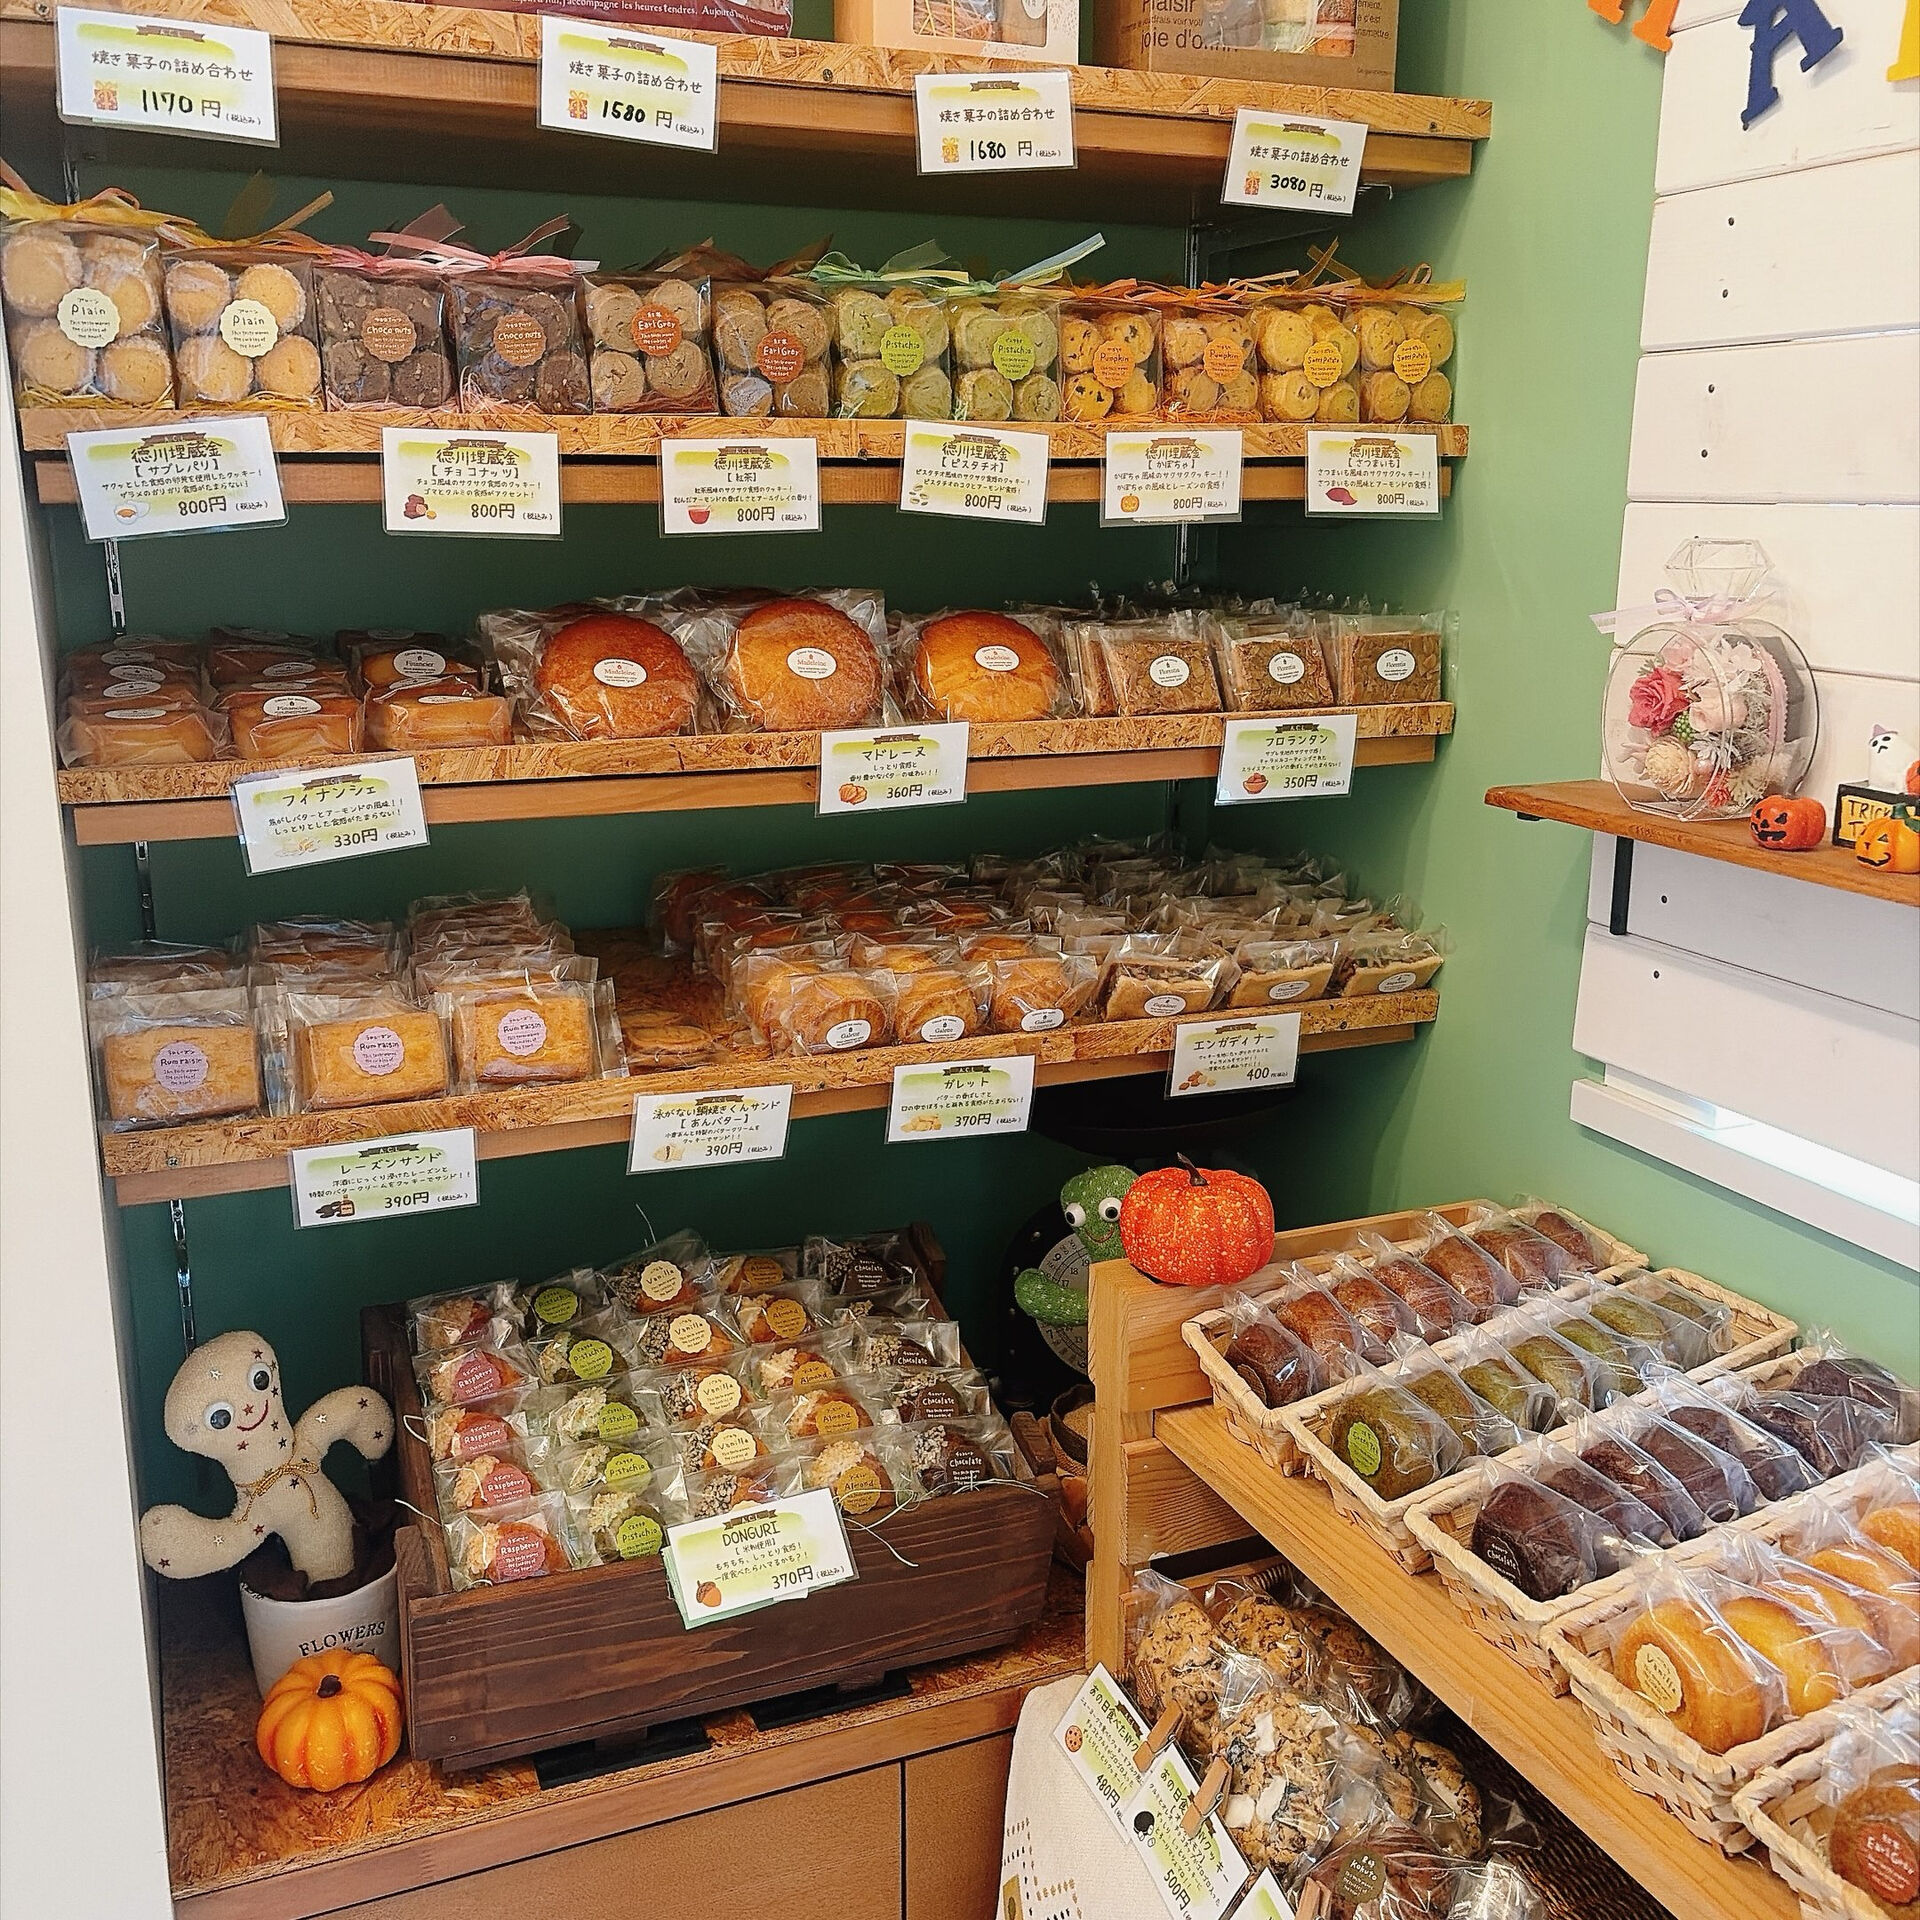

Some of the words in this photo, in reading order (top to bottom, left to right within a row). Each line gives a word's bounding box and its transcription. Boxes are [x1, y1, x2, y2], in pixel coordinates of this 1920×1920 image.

[621, 2, 633, 10] les
[635, 4, 663, 12] heures
[664, 4, 698, 15] tendres.
[1141, 27, 1168, 53] joie
[92, 49, 253, 82] 焼き菓子の詰め合わせ
[569, 60, 702, 94] 焼き菓子の詰め合わせ
[142, 89, 193, 114] 1170
[602, 100, 646, 123] 1580
[939, 108, 1055, 123] 焼き菓子の詰め合わせ
[970, 140, 1007, 161] 1680
[1250, 146, 1350, 167] 焼き菓子の詰め合わせ
[1270, 174, 1307, 191] 3080
[72, 304, 106, 315] Plain
[233, 315, 264, 326] Plain
[498, 333, 523, 341] Choco
[886, 341, 920, 349] Pistachio
[998, 346, 1032, 354] Pistachio
[131, 441, 222, 463] 徳川埋蔵金
[437, 450, 519, 466] 徳川埋蔵金
[942, 442, 1011, 462] 徳川埋蔵金
[1146, 446, 1201, 460] 徳川埋蔵金
[1349, 447, 1402, 458] 徳川埋蔵金
[714, 457, 773, 470] 徳川埋蔵金
[179, 496, 227, 516] 800円
[965, 494, 1001, 510] 800円
[1173, 497, 1203, 509] 800円
[1377, 493, 1405, 505] 800円
[471, 503, 515, 519] 800円
[737, 506, 775, 522] 800円
[1266, 735, 1328, 746] フロランタン
[862, 747, 926, 761] マドレーヌ
[1284, 775, 1317, 788] 350円
[282, 785, 377, 806] フィナンシェ
[887, 784, 923, 799] 360円
[334, 828, 378, 848] 330円
[1194, 1034, 1275, 1050] エンガディナー
[944, 1077, 989, 1089] ガレット
[955, 1113, 991, 1127] 370円
[706, 1142, 742, 1157] 390円
[341, 1152, 442, 1174] レーズンサンド
[385, 1192, 429, 1208] 390円
[855, 1263, 883, 1272] Chocolate
[647, 1268, 674, 1285] Vanilla
[674, 1322, 703, 1336] Vanilla
[897, 1357, 928, 1365] Chocolate
[458, 1368, 494, 1388] Raspberry
[800, 1373, 828, 1384] Almond
[703, 1383, 735, 1396] Vanilla
[923, 1397, 955, 1405] Chocolate
[822, 1412, 852, 1422] Almond
[464, 1428, 501, 1444] Raspberry
[718, 1438, 749, 1450] Vanilla
[609, 1463, 645, 1477] Pistachio
[950, 1458, 982, 1468] Chocolate
[487, 1478, 526, 1492] Raspberry
[845, 1480, 874, 1490] Almond
[622, 1528, 658, 1541] Pistachio
[723, 1521, 781, 1547] DONGURI
[501, 1540, 539, 1555] Raspberry
[1487, 1550, 1517, 1570] Chocolate
[772, 1565, 813, 1590] 370円
[299, 1621, 385, 1656] FLOWERS
[1646, 1652, 1676, 1693] Vanilla
[1089, 1684, 1139, 1753] あの日食べたNYク
[1095, 1774, 1121, 1809] 480円
[1349, 1860, 1378, 1881] Kokuto
[1163, 1868, 1192, 1911] 500円
